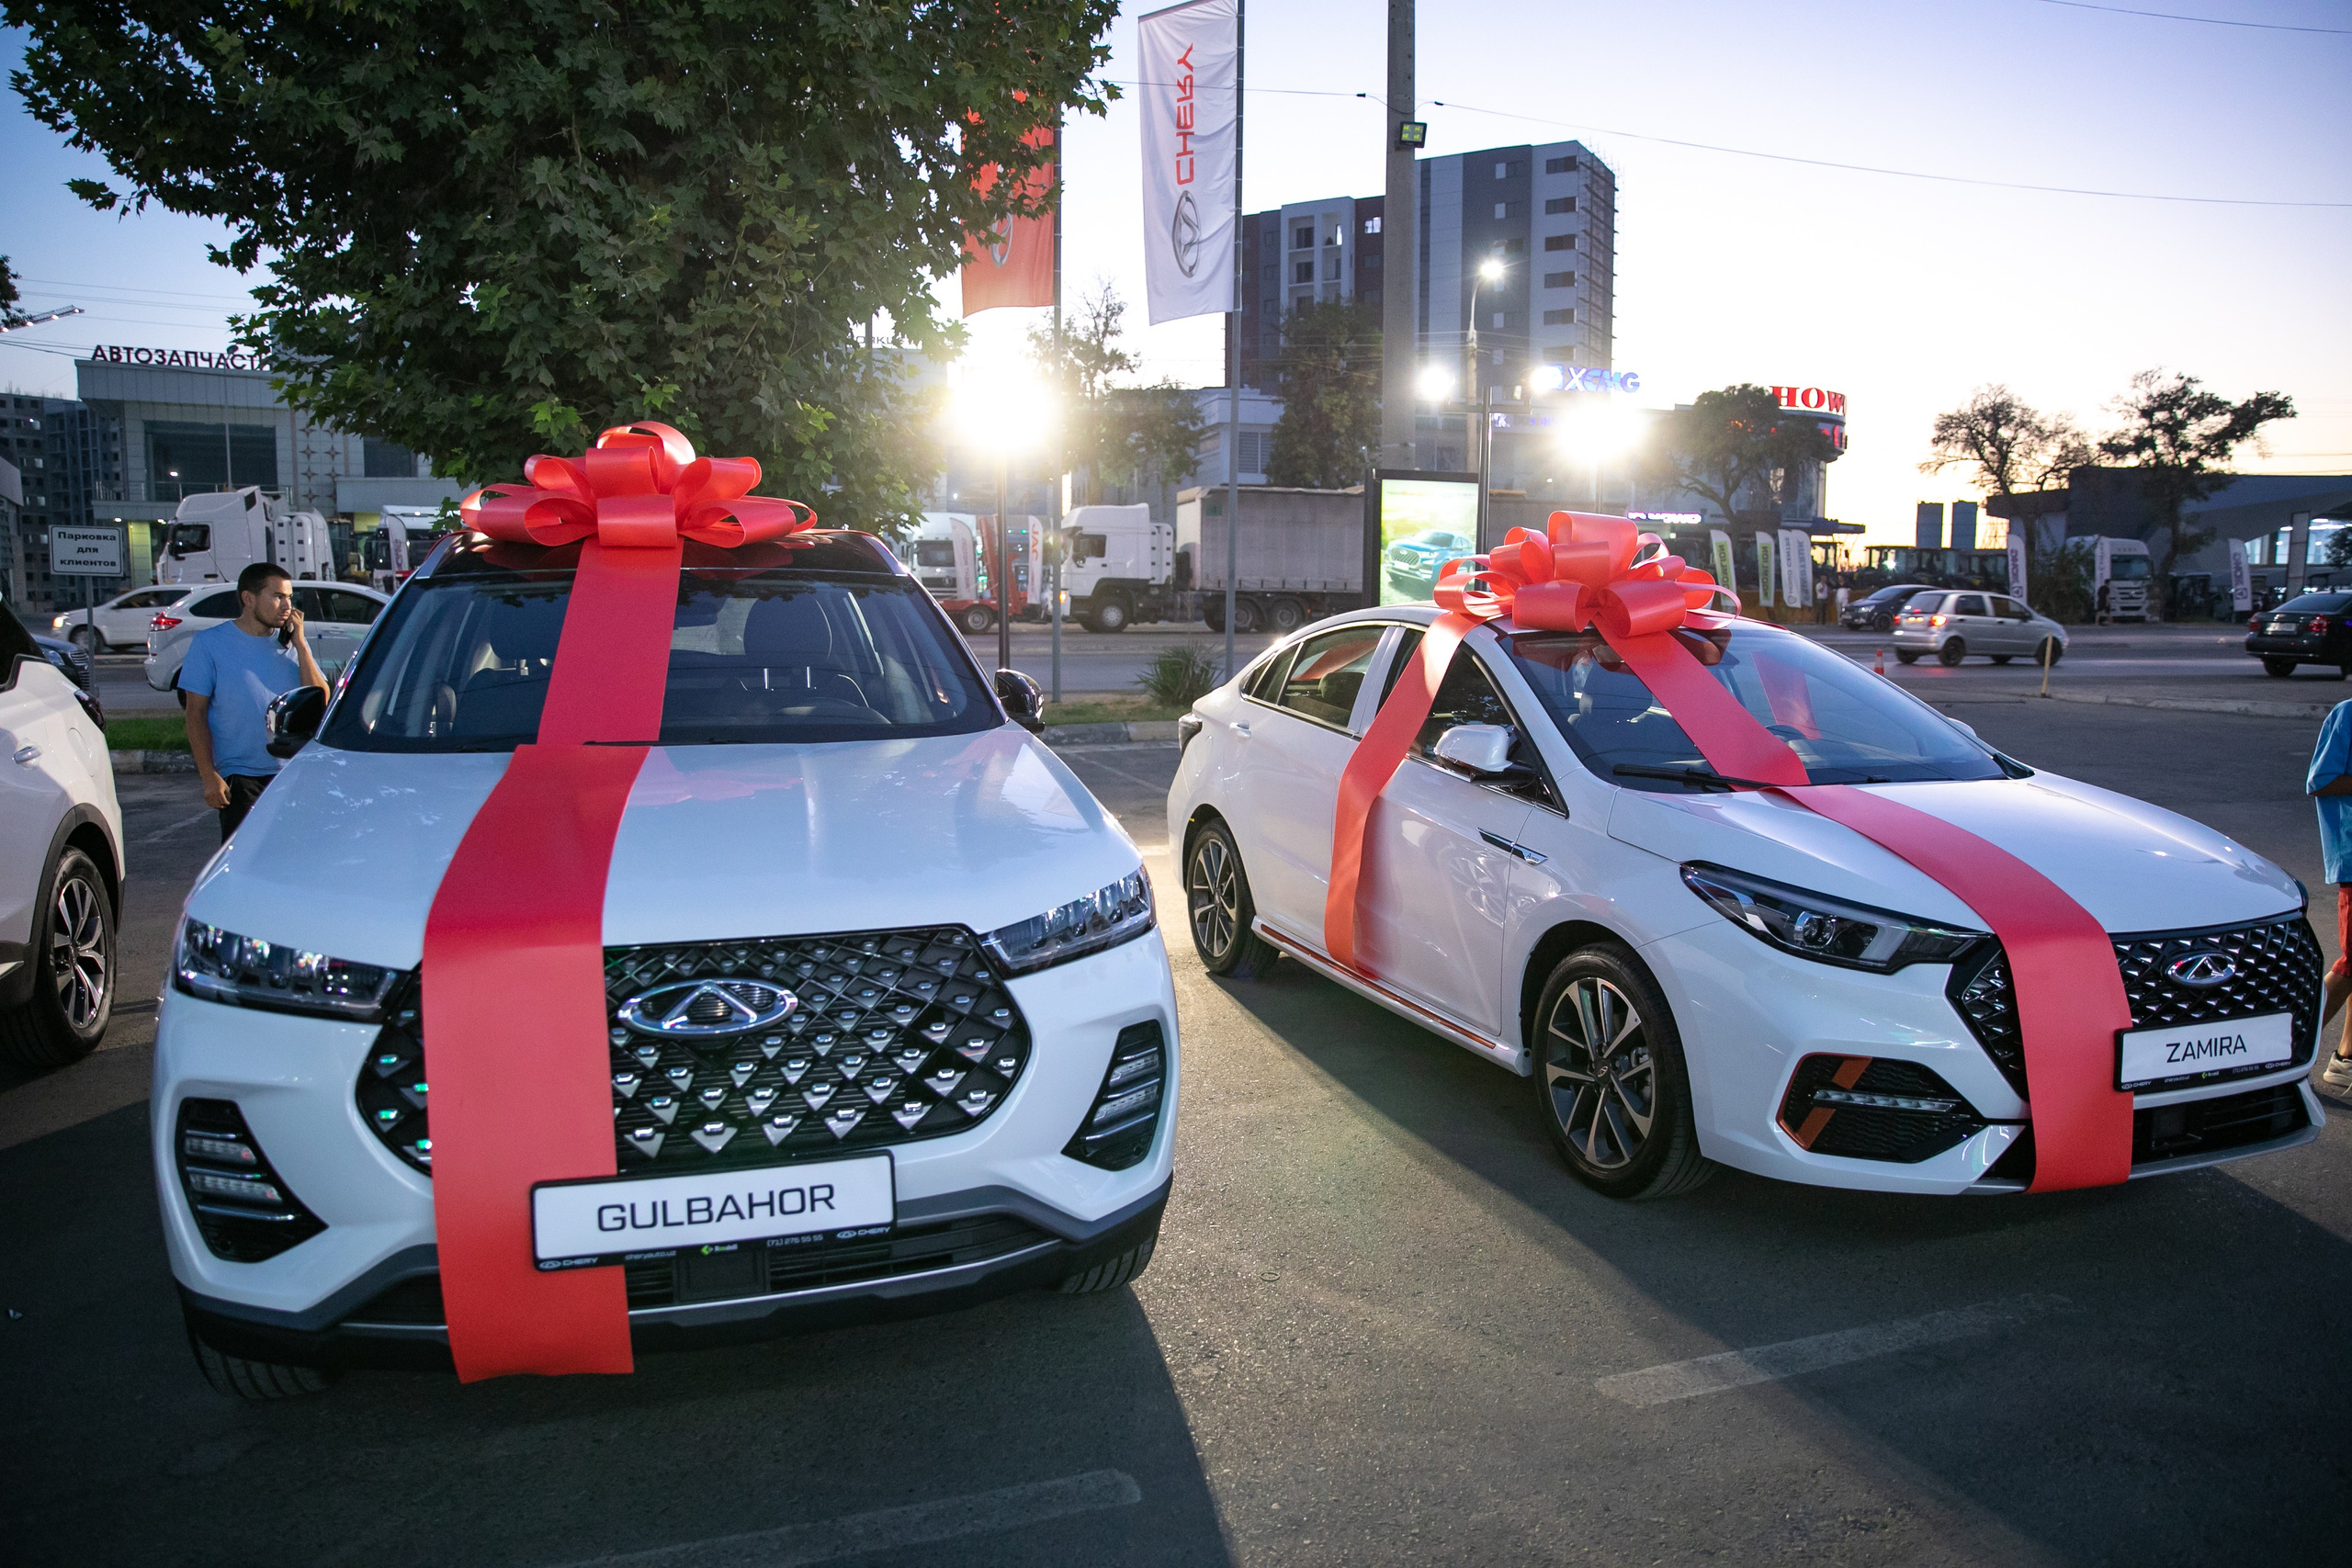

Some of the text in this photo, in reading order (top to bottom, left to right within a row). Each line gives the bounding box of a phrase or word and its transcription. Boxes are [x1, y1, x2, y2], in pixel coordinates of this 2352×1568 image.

[1176, 43, 1194, 185] CHERY
[1565, 367, 1640, 393] XCMG
[58, 531, 117, 541] Парковка
[60, 558, 117, 567] клиентов
[2165, 1034, 2247, 1064] ZAMIRA
[597, 1183, 835, 1232] GULBAHOR
[857, 1226, 891, 1235] CHERY
[562, 1258, 598, 1267] CHERY
